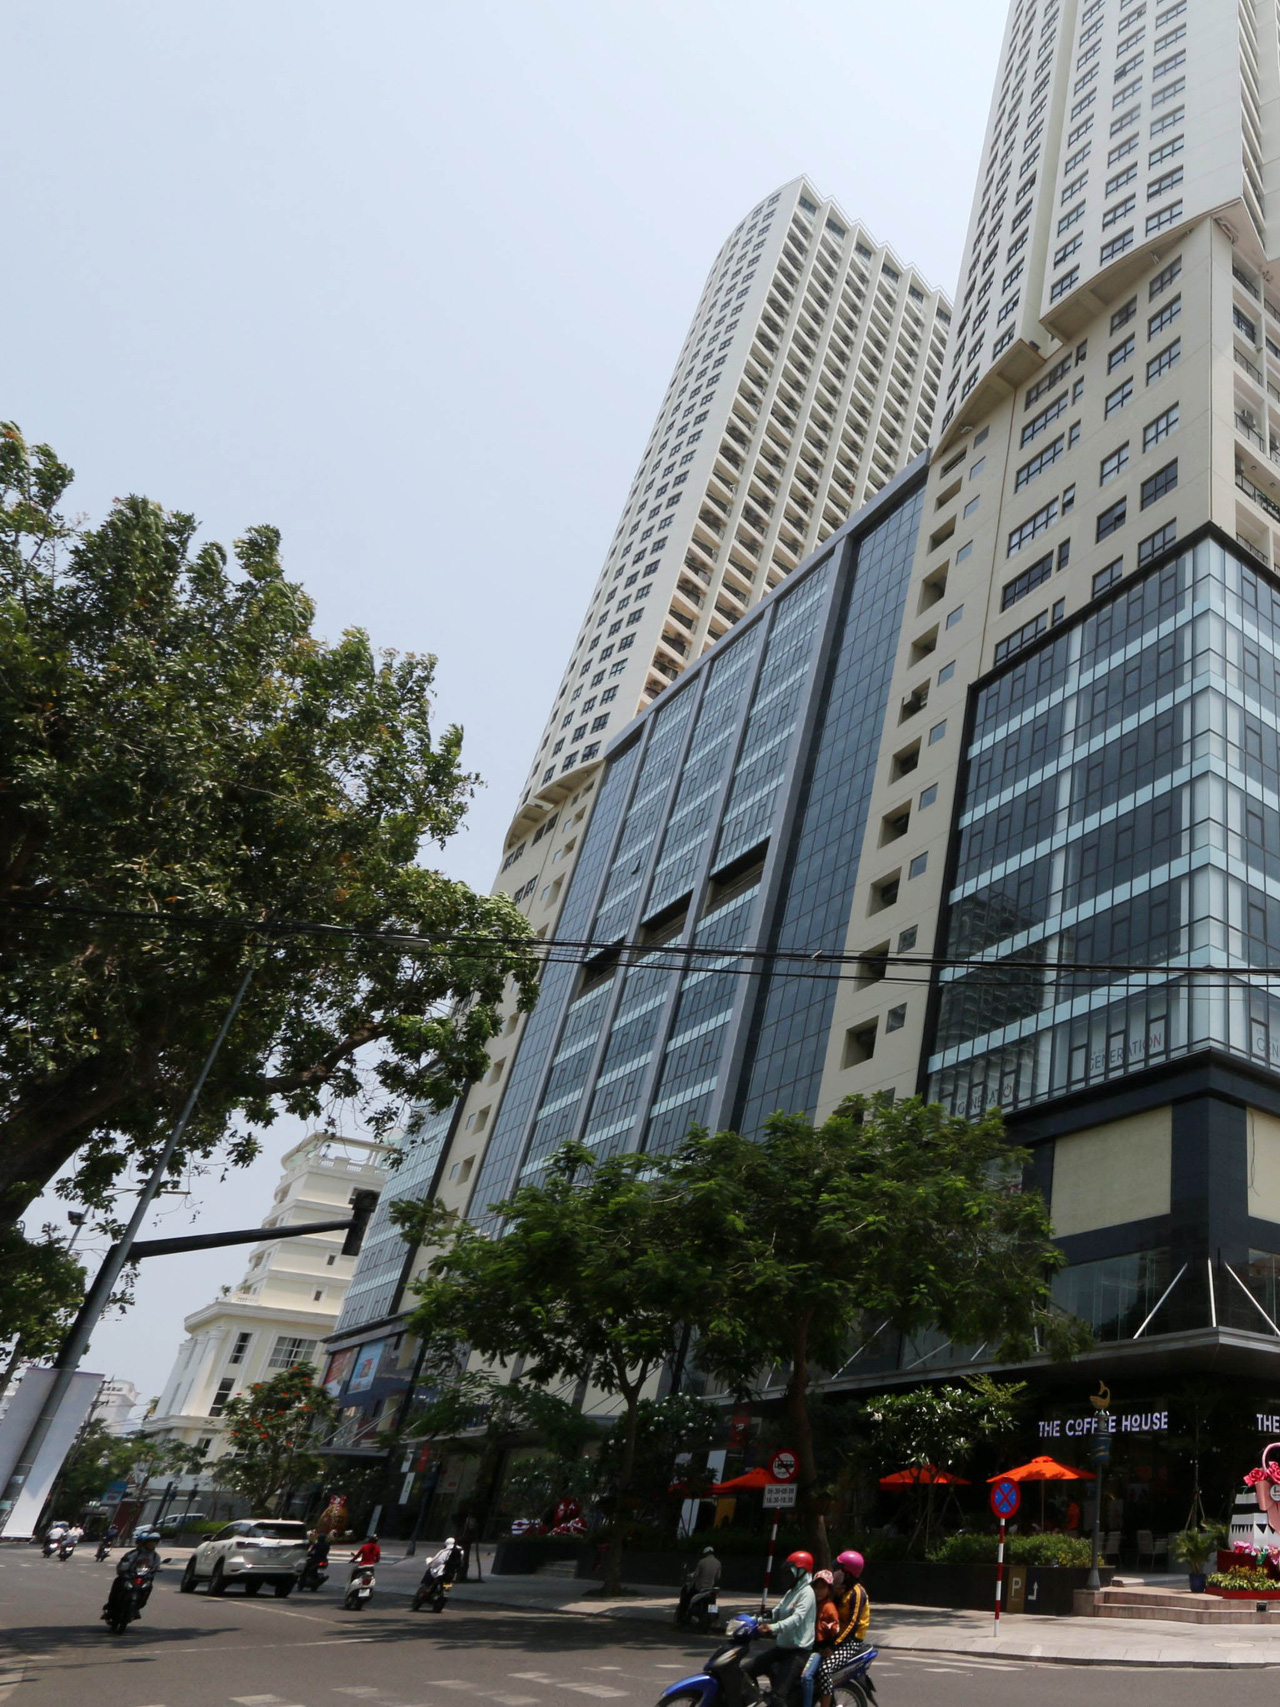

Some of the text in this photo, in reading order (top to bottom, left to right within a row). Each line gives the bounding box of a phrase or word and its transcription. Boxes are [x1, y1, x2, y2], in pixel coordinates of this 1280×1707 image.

[1039, 1411, 1168, 1437] THE COFFE HOUSE
[1256, 1413, 1280, 1433] THE
[1011, 1577, 1022, 1597] P
